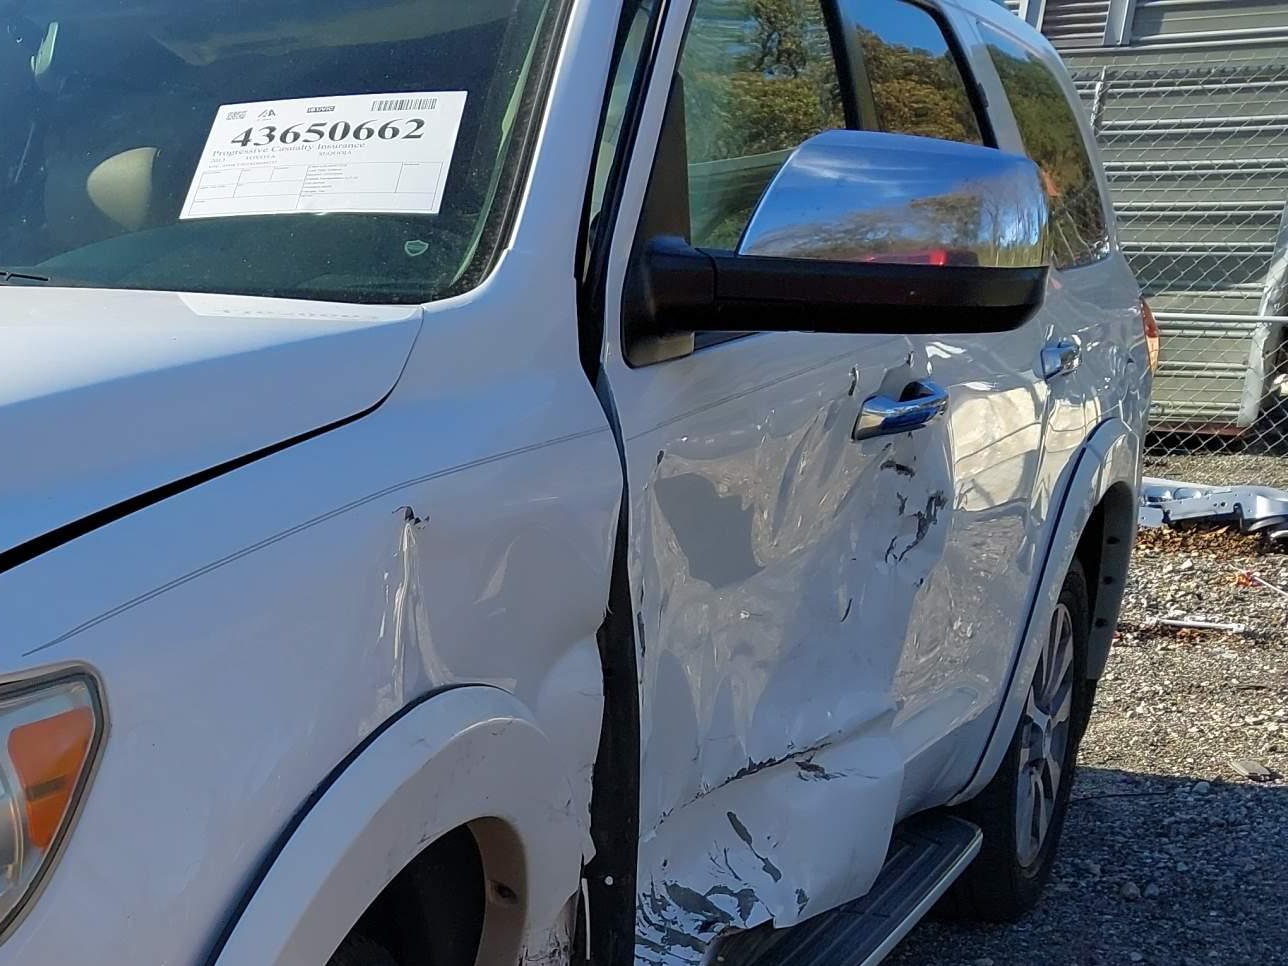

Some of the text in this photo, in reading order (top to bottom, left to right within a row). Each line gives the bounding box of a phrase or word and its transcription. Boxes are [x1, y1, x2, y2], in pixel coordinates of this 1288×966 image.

[230, 118, 426, 147] 43650662
[212, 141, 366, 158] Progressive Casualty Insurance
